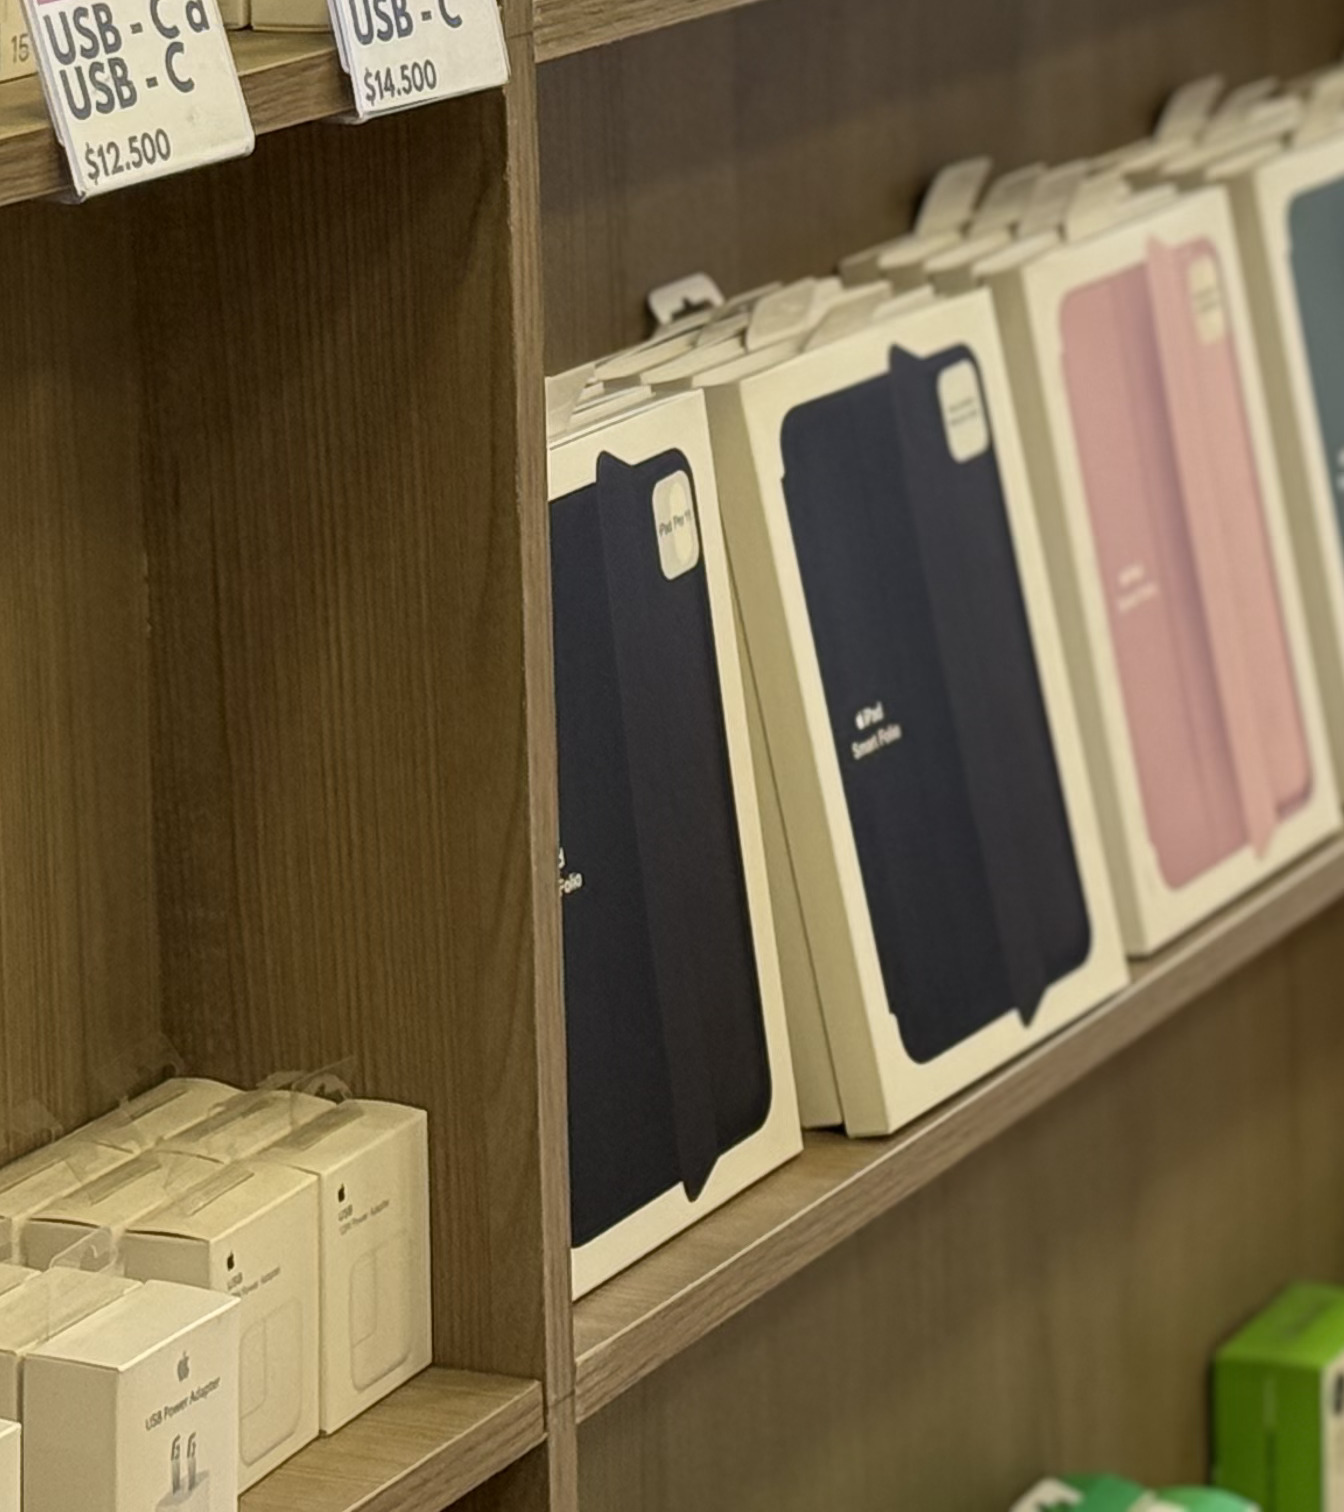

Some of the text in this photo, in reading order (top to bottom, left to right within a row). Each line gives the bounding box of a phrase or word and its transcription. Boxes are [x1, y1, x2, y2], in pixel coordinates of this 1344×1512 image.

[43, 2, 123, 66] USB
[59, 56, 138, 120] USB
[165, 41, 195, 94] C
[364, 59, 438, 106] $14.500
[84, 128, 172, 185] $12.500
